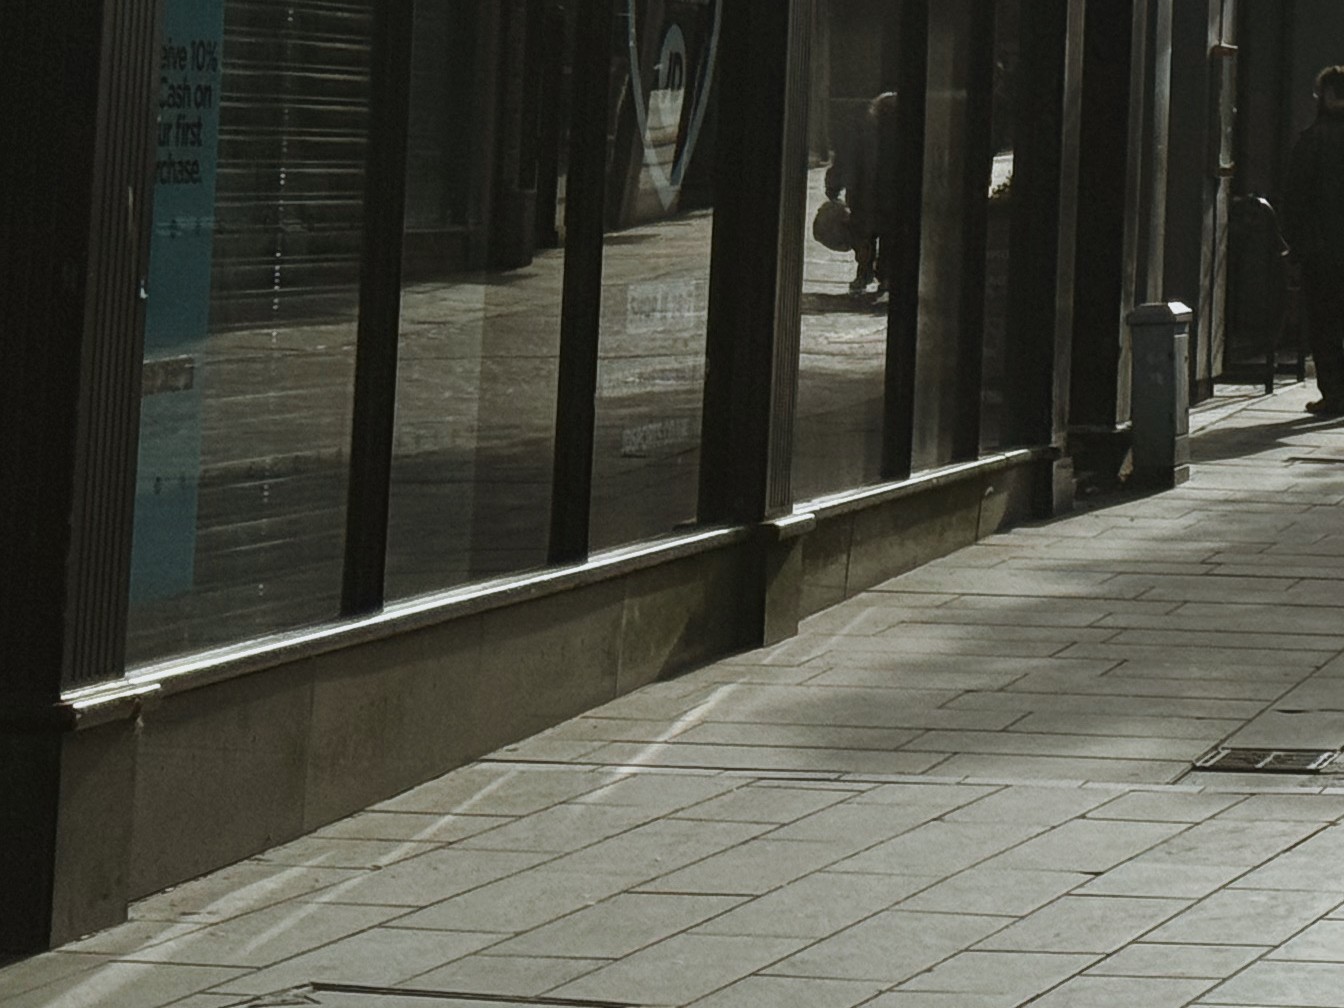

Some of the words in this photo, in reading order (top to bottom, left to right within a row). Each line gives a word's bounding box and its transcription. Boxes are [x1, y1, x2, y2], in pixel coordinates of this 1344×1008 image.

[191, 39, 219, 73] 10%
[194, 84, 213, 110] on
[175, 113, 203, 147] first
